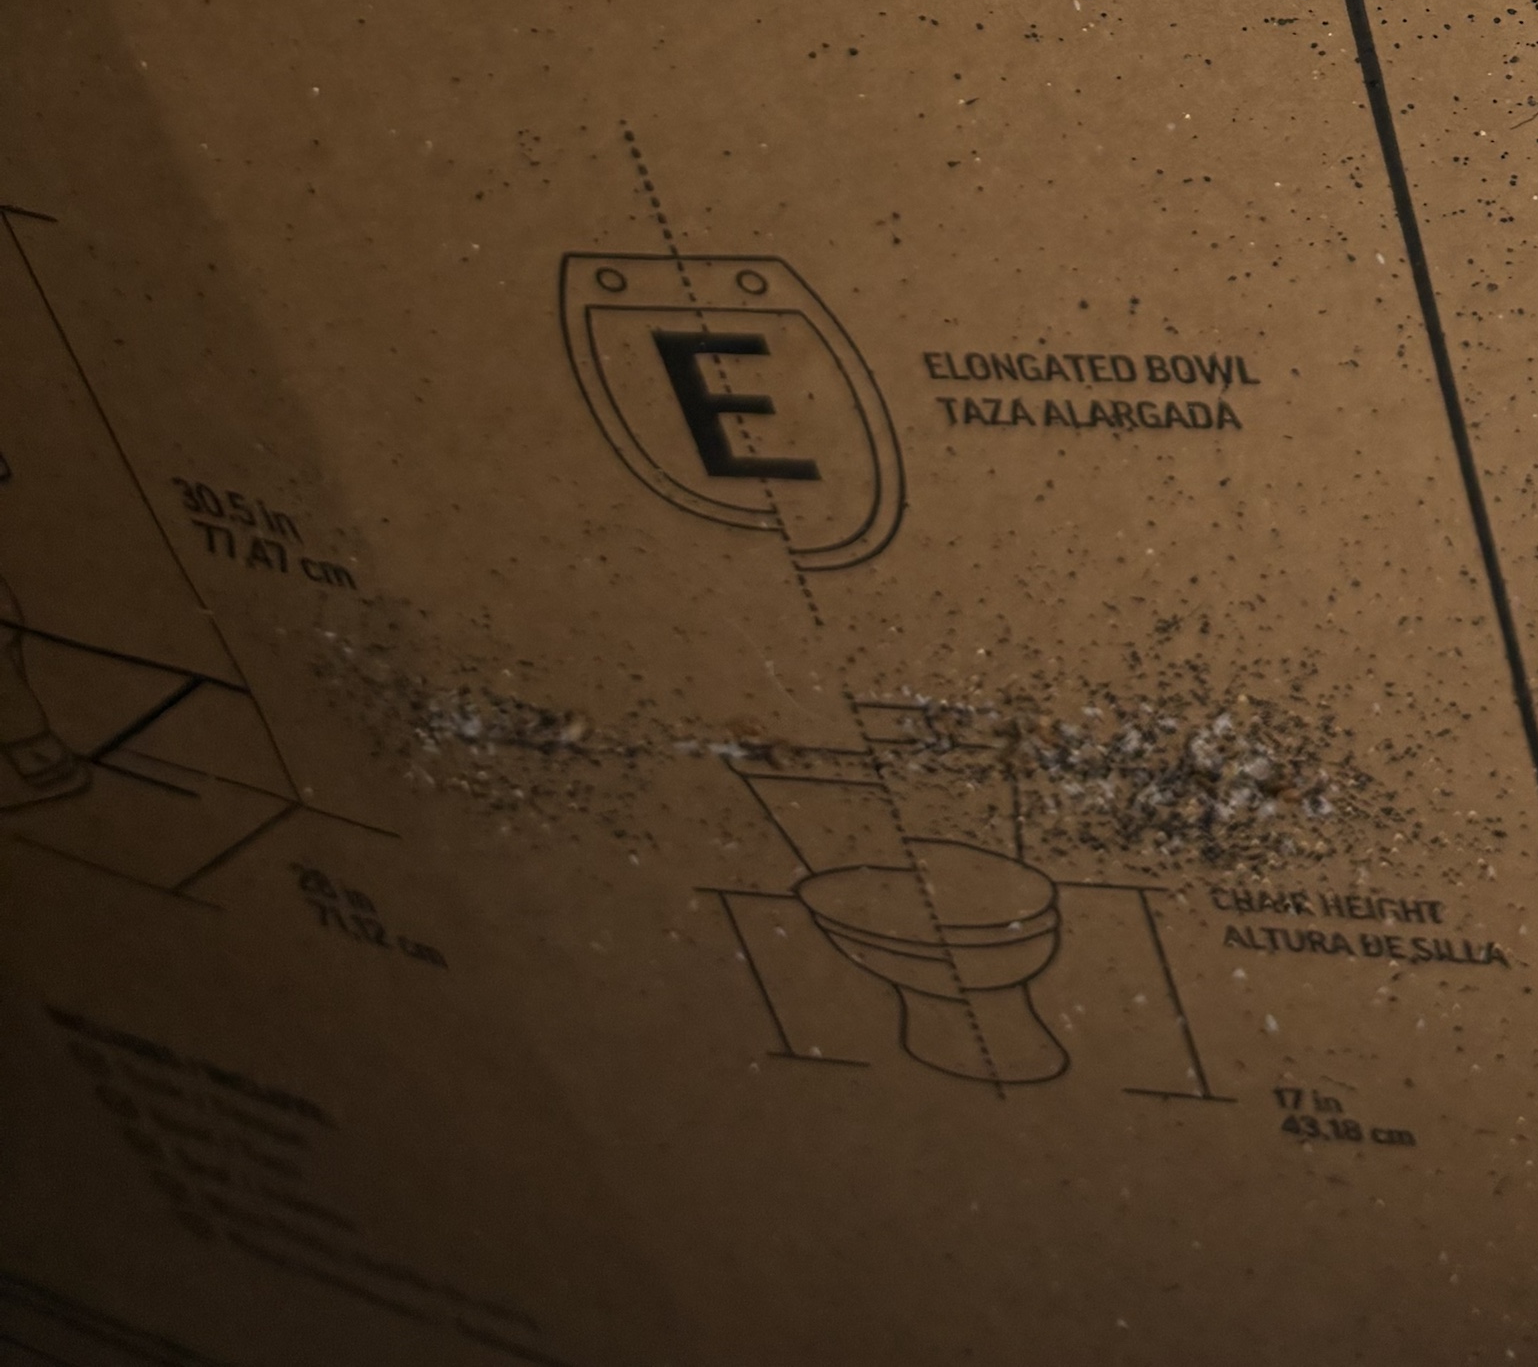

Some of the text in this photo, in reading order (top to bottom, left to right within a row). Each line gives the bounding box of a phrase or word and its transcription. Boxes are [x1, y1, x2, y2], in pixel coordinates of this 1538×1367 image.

[923, 351, 1262, 386] ELONGATED BOWL
[651, 328, 822, 481] E
[935, 395, 1245, 432] TAZA ALARGADA
[255, 498, 304, 544] in
[299, 555, 358, 590] cm
[1318, 891, 1446, 925] HEIGHT
[1222, 923, 1356, 958] ALTURA
[1273, 1086, 1304, 1111] 17
